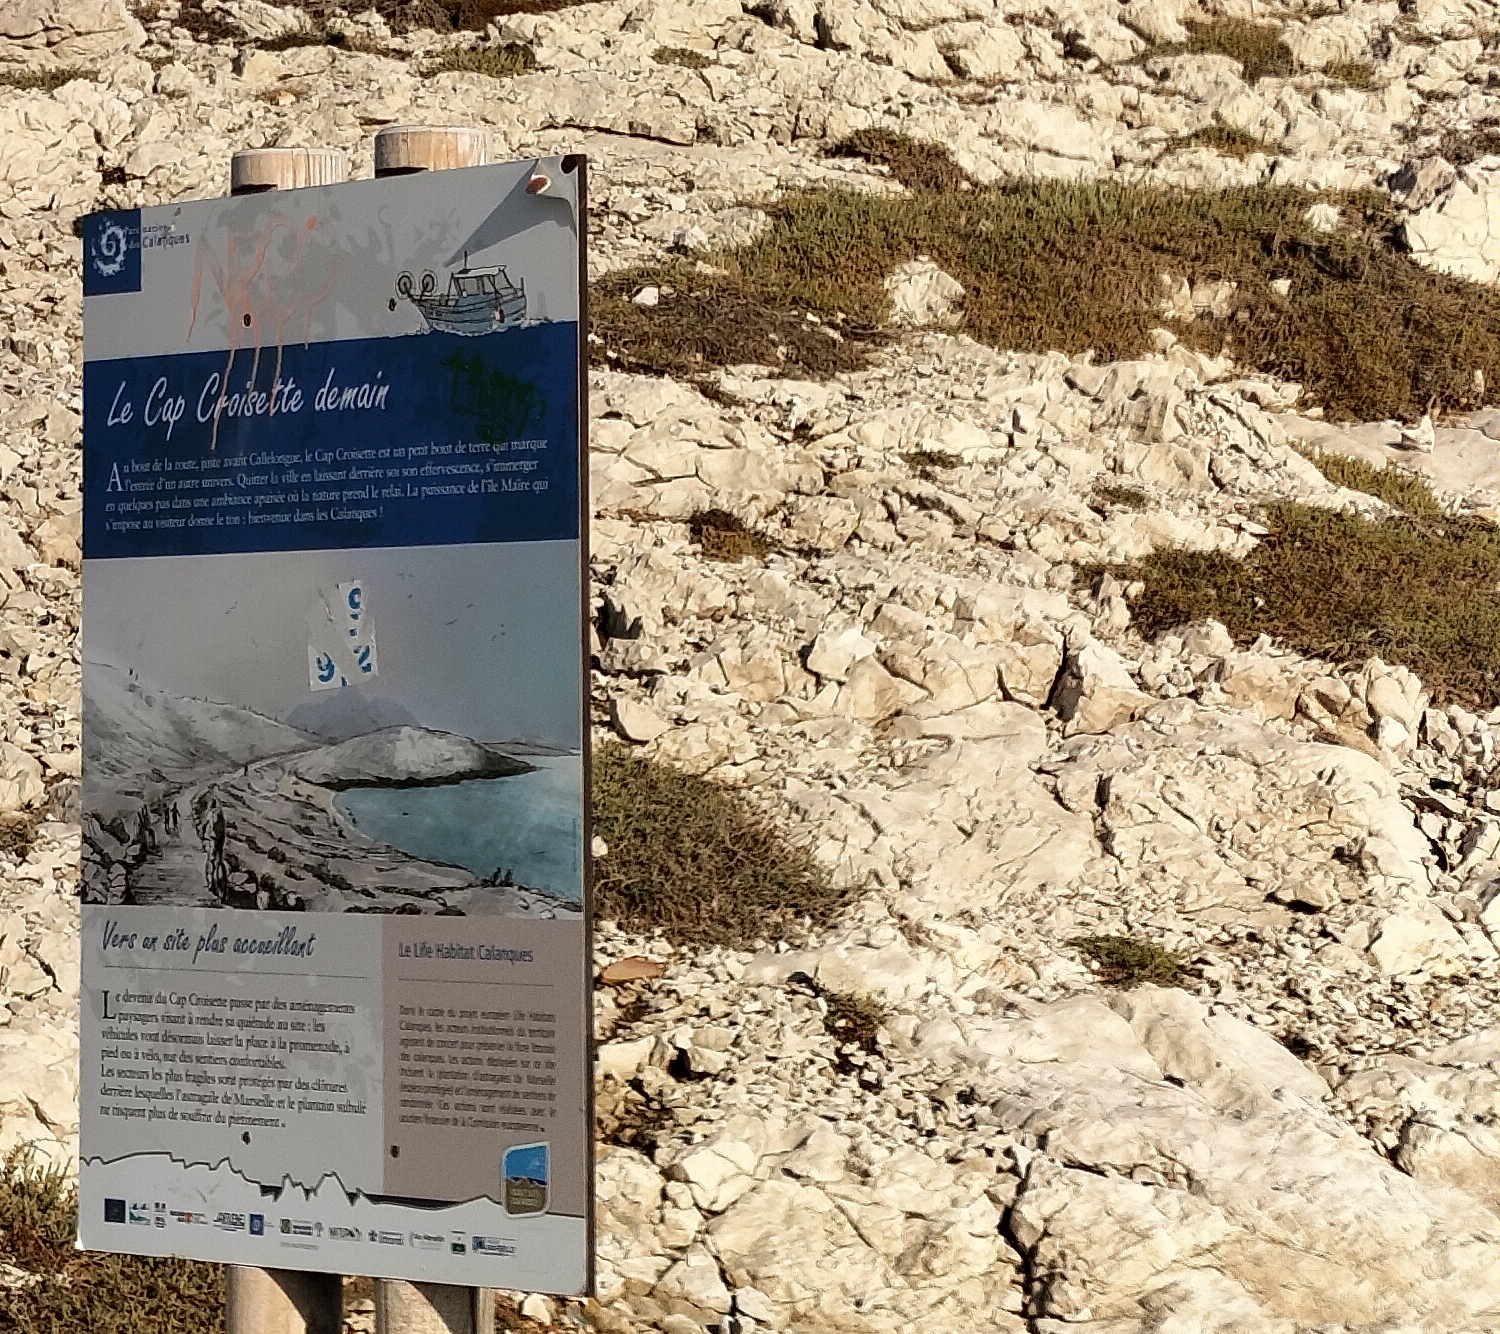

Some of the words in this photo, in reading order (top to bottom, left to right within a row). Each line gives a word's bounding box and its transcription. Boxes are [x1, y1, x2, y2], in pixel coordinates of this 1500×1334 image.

[106, 380, 133, 427] Le
[144, 376, 186, 442] Cap
[197, 372, 304, 424] Croisette
[314, 367, 390, 412] demain
[315, 449, 334, 464] Cap
[102, 920, 138, 951] Vers
[162, 927, 192, 951] site
[191, 923, 229, 965] plus
[232, 925, 317, 958] accueillant
[477, 944, 534, 966] Calanques
